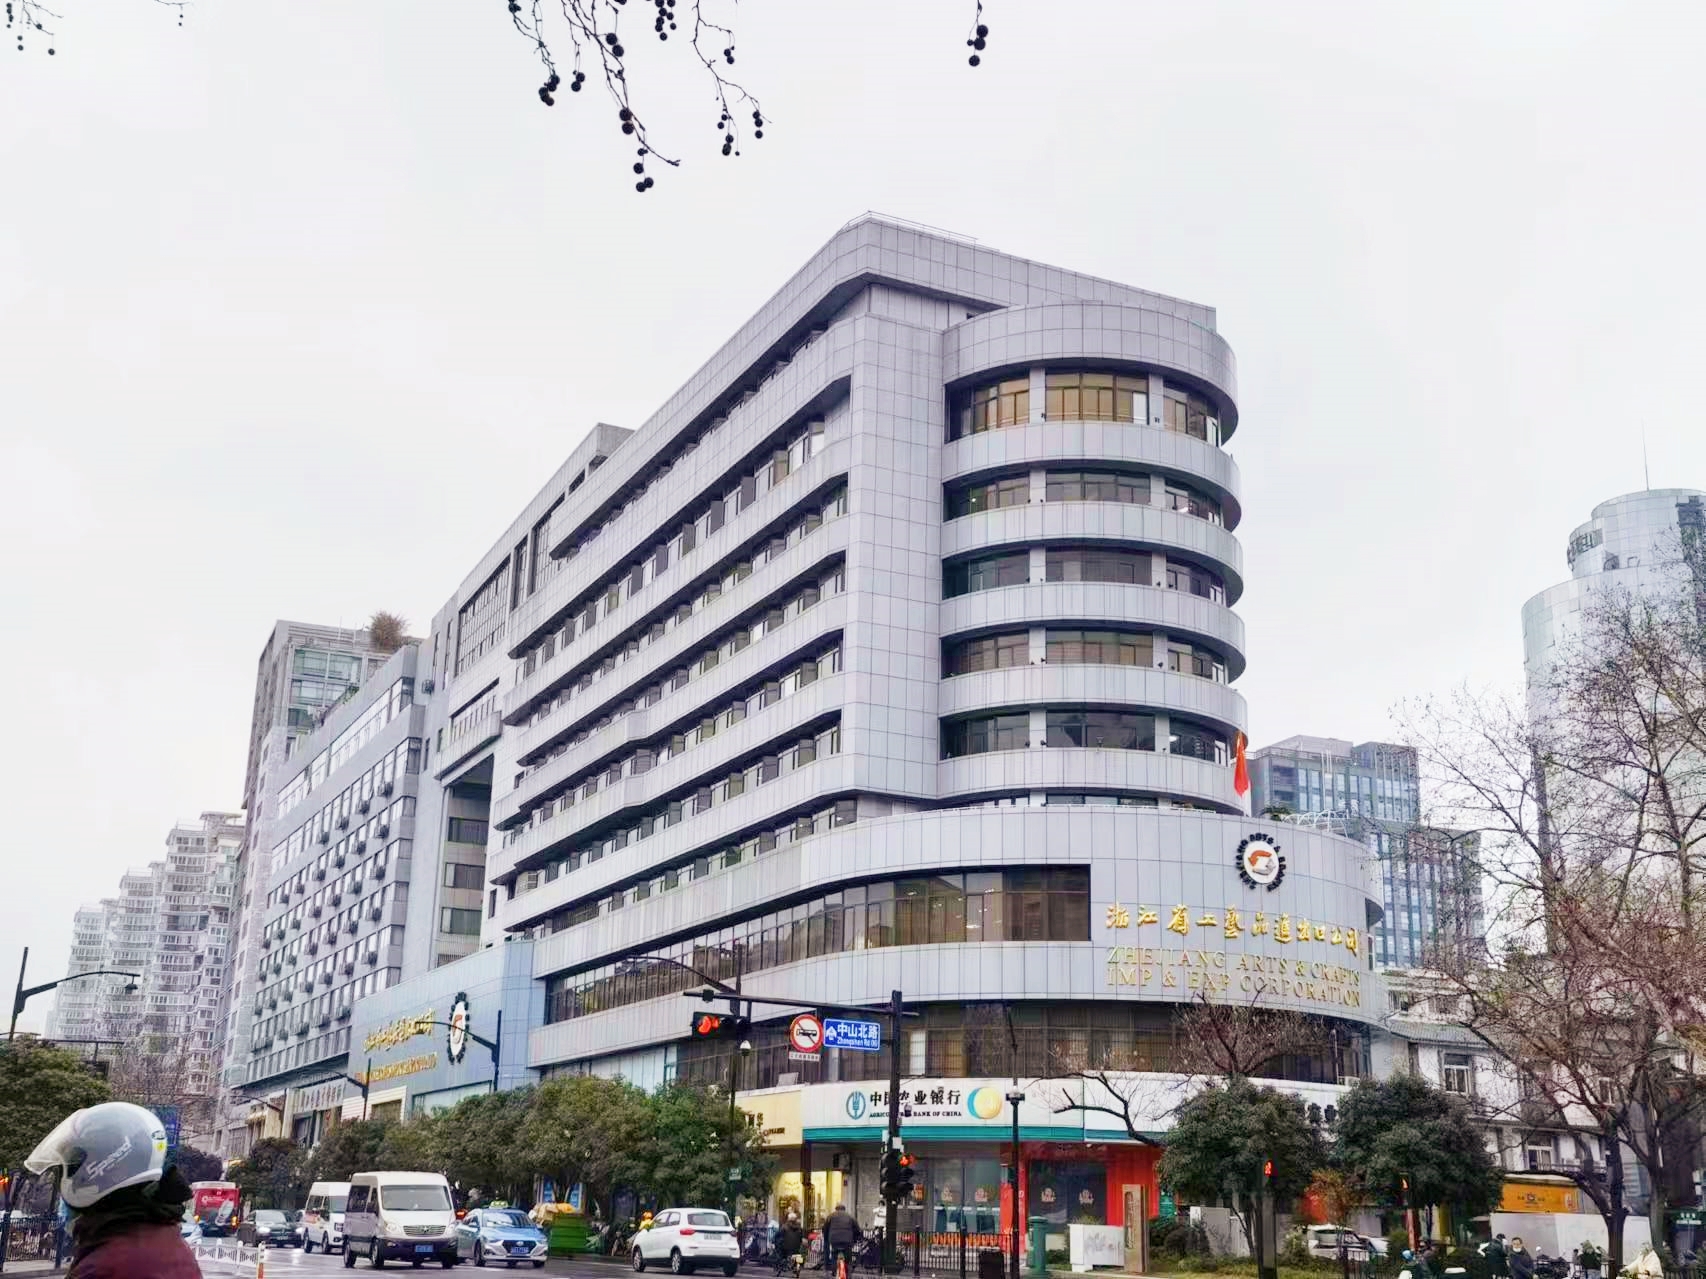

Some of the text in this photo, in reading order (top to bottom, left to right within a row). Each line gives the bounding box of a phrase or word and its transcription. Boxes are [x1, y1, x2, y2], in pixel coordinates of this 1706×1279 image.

[1107, 946, 1360, 987] ZHEJIANG ARTS & CRAFTS
[1107, 967, 1360, 1008] IMP & EXP CORPORATION
[837, 1022, 878, 1040] 中山北路
